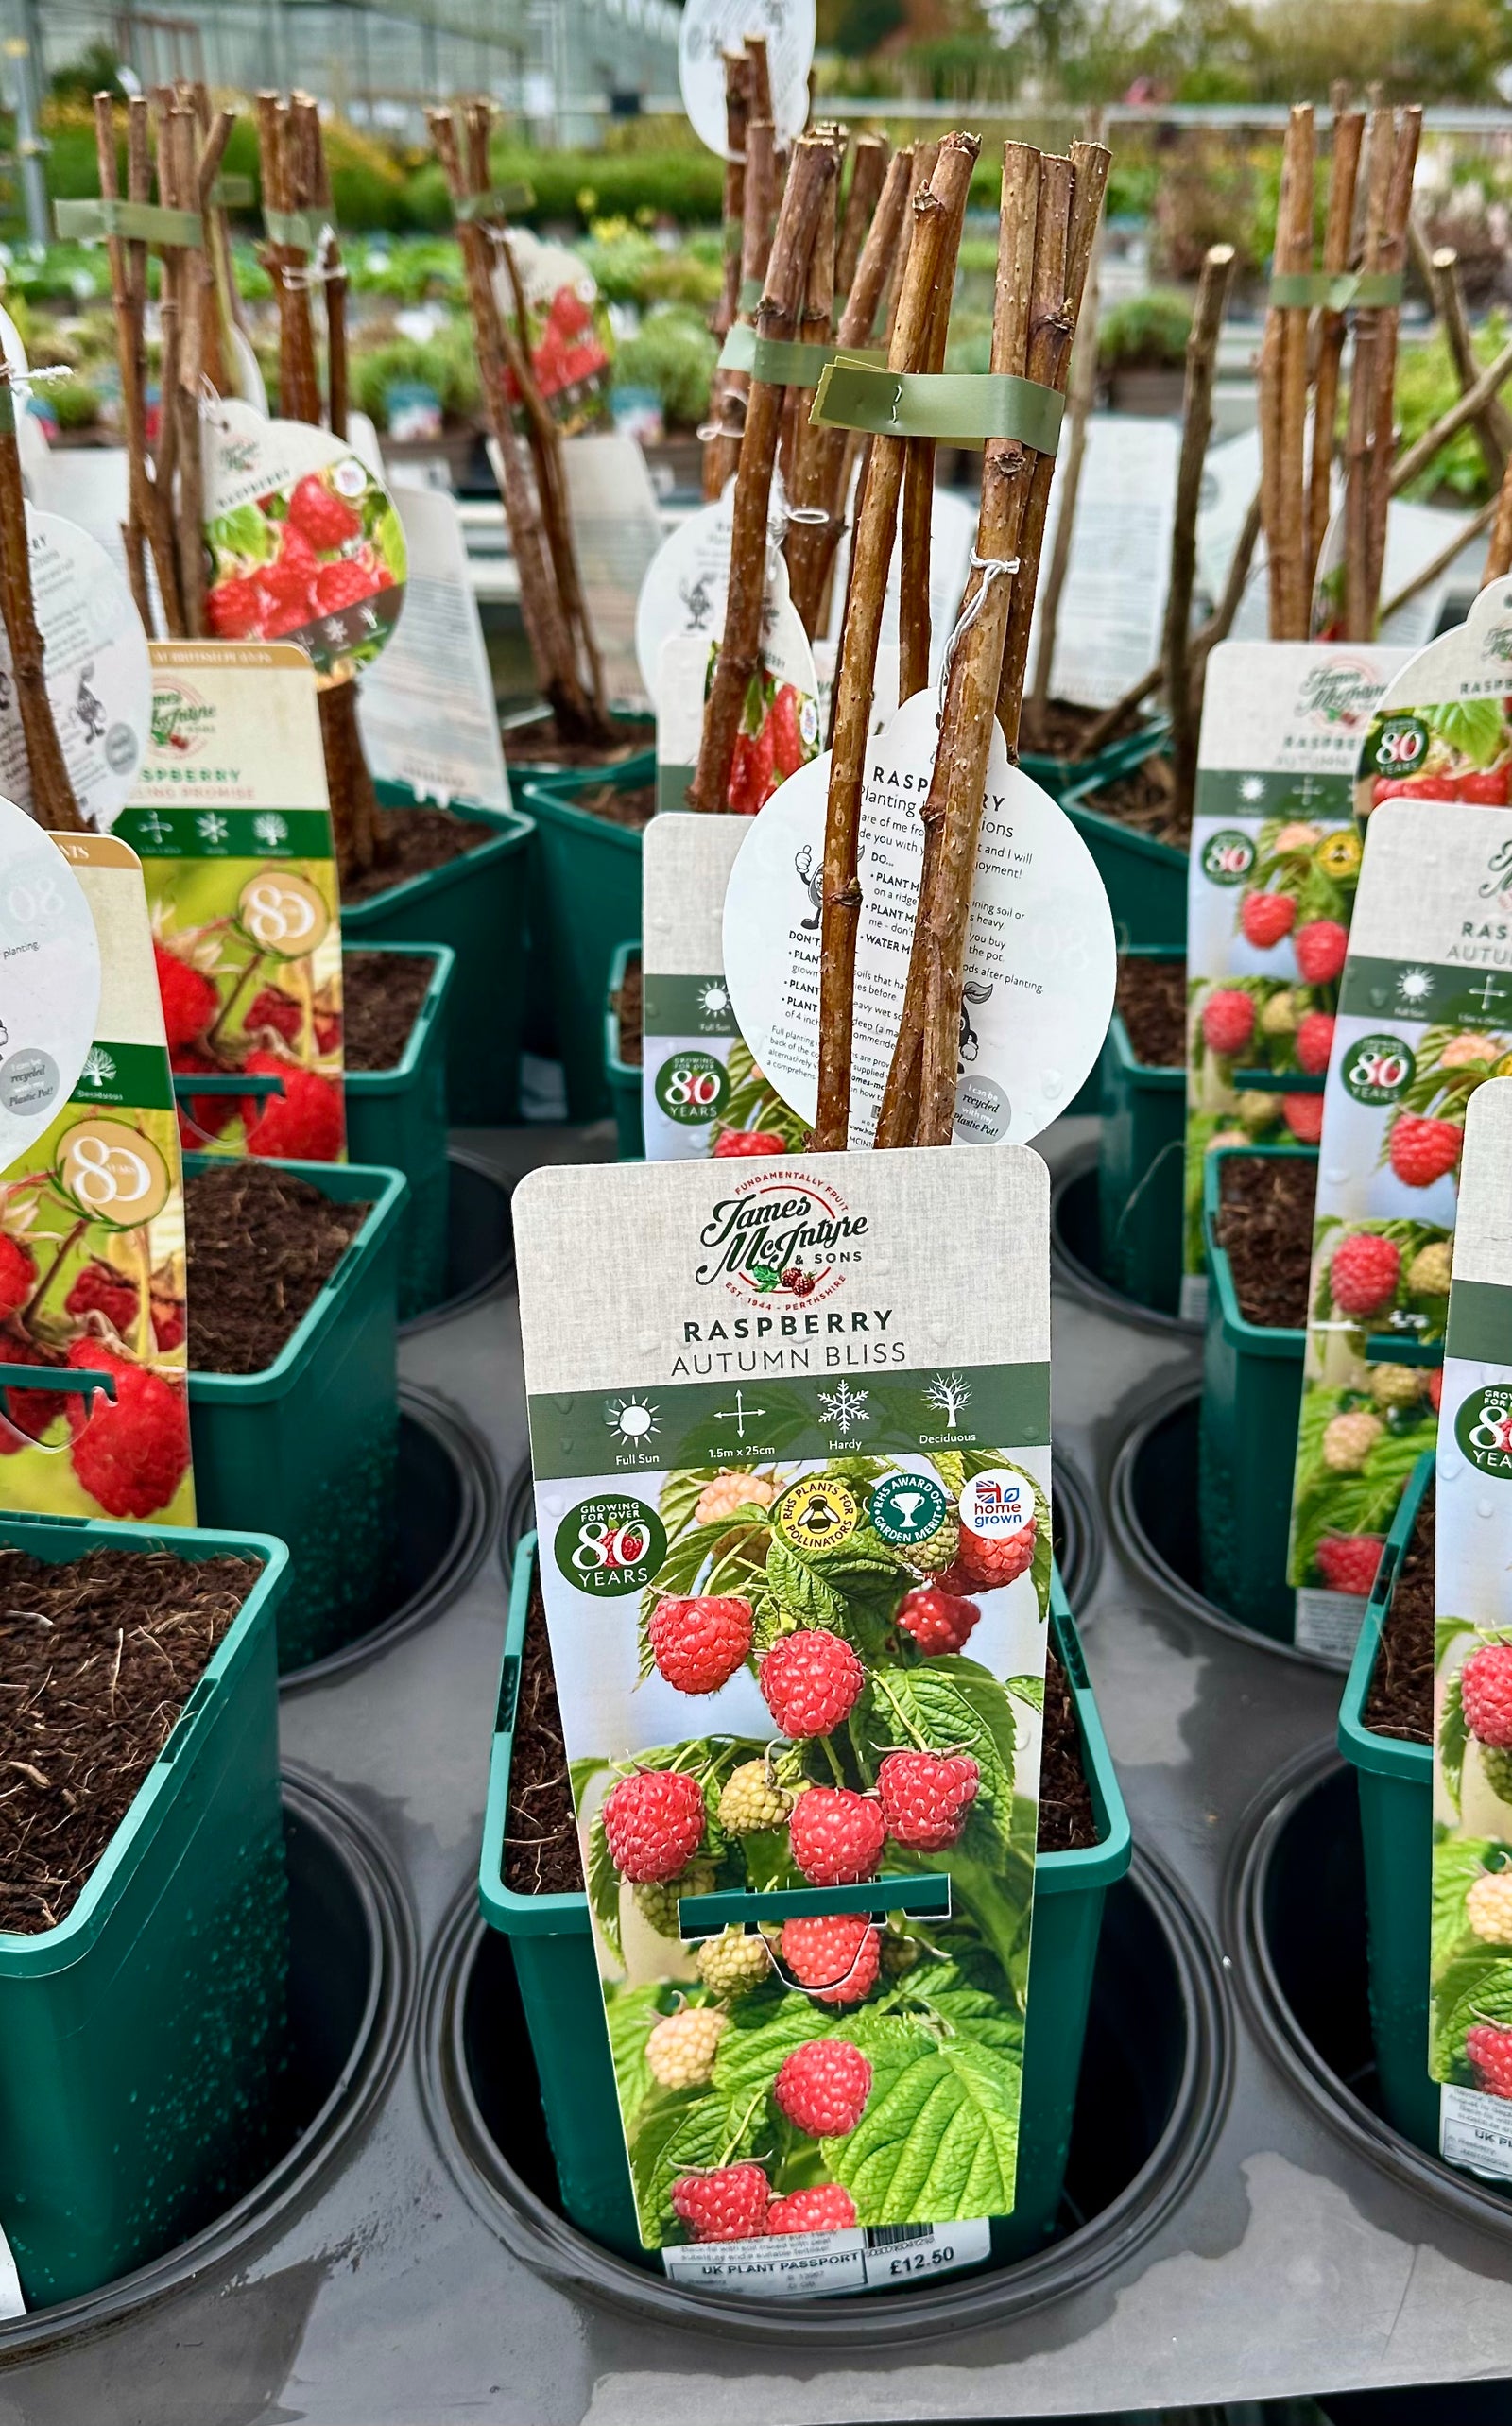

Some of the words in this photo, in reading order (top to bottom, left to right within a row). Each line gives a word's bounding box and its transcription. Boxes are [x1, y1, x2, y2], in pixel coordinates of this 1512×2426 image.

[1375, 731, 1424, 764] 80
[142, 767, 240, 783] SPBERRY
[874, 834, 893, 846] you
[895, 837, 918, 852] with
[879, 817, 891, 828] of
[892, 821, 908, 834] me
[985, 844, 1005, 859] and
[1014, 852, 1033, 866] will
[873, 886, 886, 896] on
[876, 871, 910, 889] PLANT
[997, 905, 1013, 918] soil
[1015, 911, 1025, 921] or
[868, 918, 883, 929] me
[969, 944, 984, 957] the
[870, 902, 904, 921] PLANT
[969, 932, 987, 945] you
[988, 934, 1006, 951] buy
[794, 949, 821, 964] PLAN
[873, 973, 892, 987] that
[866, 933, 900, 953] WATER
[981, 967, 1004, 981] after
[787, 995, 818, 1013] PLANT
[790, 979, 821, 996] PLANT
[875, 1007, 892, 1019] wet
[770, 1036, 787, 1048] back
[853, 1063, 885, 1079] supplied
[860, 1055, 871, 1065] are
[1349, 1050, 1409, 1087] 80
[10, 1064, 45, 1084] recycled
[665, 1070, 721, 1105] 80
[972, 1087, 987, 1097] can
[988, 1091, 999, 1103] be
[670, 1106, 718, 1117] YEARS
[962, 1094, 1000, 1113] recycled
[962, 1107, 980, 1119] with
[980, 1113, 993, 1125] my
[980, 1124, 999, 1137] Pot!
[72, 1135, 151, 1204] 80
[734, 1171, 824, 1196] FUNDAMENTALLY
[824, 1185, 849, 1212] FRUIT
[700, 1194, 812, 1247] James
[695, 1215, 869, 1286] McIntyre
[795, 1254, 804, 1265] &
[814, 1251, 863, 1265] SONS
[725, 1281, 744, 1300] EST.
[747, 1296, 772, 1311] 1944
[785, 1274, 847, 1312] PERTHSHIRE
[683, 1309, 893, 1343] RASPBERRY
[671, 1348, 810, 1377] AUTUMN
[825, 1341, 906, 1367] BLISS
[1484, 1398, 1506, 1408] FOR
[708, 1448, 733, 1459] 1.5m
[745, 1445, 775, 1456] 25cm
[829, 1439, 862, 1451] Hardy
[919, 1433, 977, 1445] Deciduous
[615, 1454, 636, 1466] Full
[638, 1453, 660, 1465] Sun
[782, 1497, 797, 1520] RHS
[795, 1481, 840, 1499] PLANTS
[839, 1493, 854, 1516] FOR
[873, 1486, 891, 1508] RHS
[891, 1476, 933, 1492] AWARD
[930, 1490, 943, 1505] OF
[580, 1502, 640, 1514] GROWING
[580, 1512, 605, 1523] FOR
[609, 1509, 641, 1521] OVER
[974, 1503, 1021, 1516] home
[974, 1514, 1022, 1528] grown
[785, 1520, 852, 1548] POLLINATORS
[874, 1516, 912, 1542] GARDEN
[914, 1510, 943, 1540] MERIT
[571, 1519, 651, 1570] 80
[578, 1567, 648, 1588] YEARS
[1474, 2128, 1496, 2142] UK
[702, 2265, 724, 2275] UK
[728, 2263, 775, 2275] PLANT
[780, 2251, 858, 2271] PASSPORT
[889, 2245, 954, 2276] £12.50
